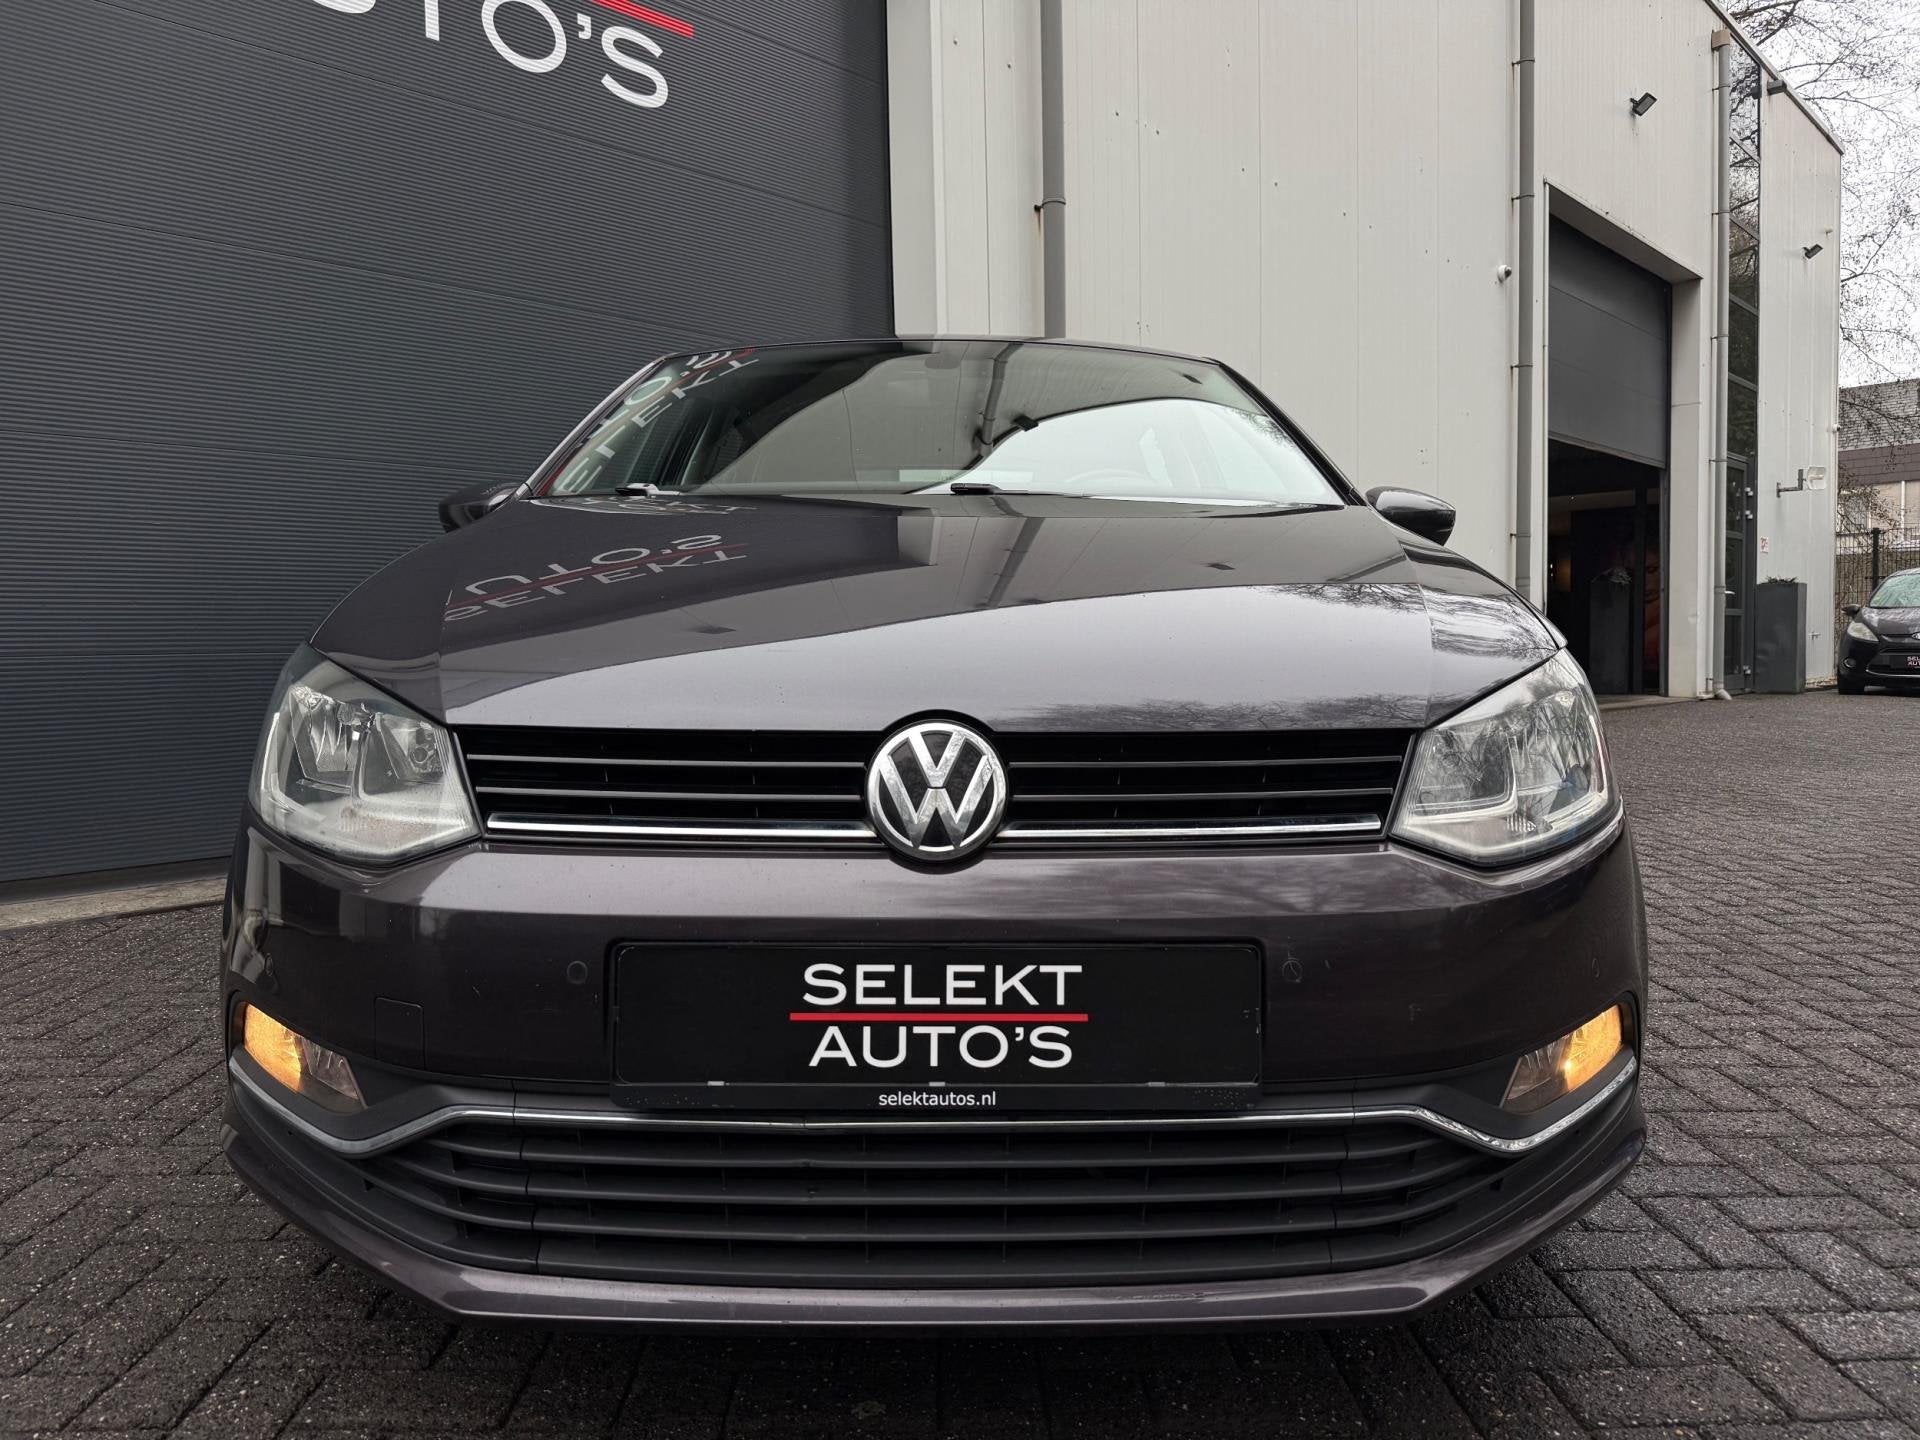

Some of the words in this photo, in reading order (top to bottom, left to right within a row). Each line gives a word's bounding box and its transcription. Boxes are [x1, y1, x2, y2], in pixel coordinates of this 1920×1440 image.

[866, 721, 1005, 858] VW
[803, 964, 1082, 1005] SELEKT
[809, 1026, 1072, 1068] AUTO'S
[878, 1090, 996, 1106] selektautos.nl
